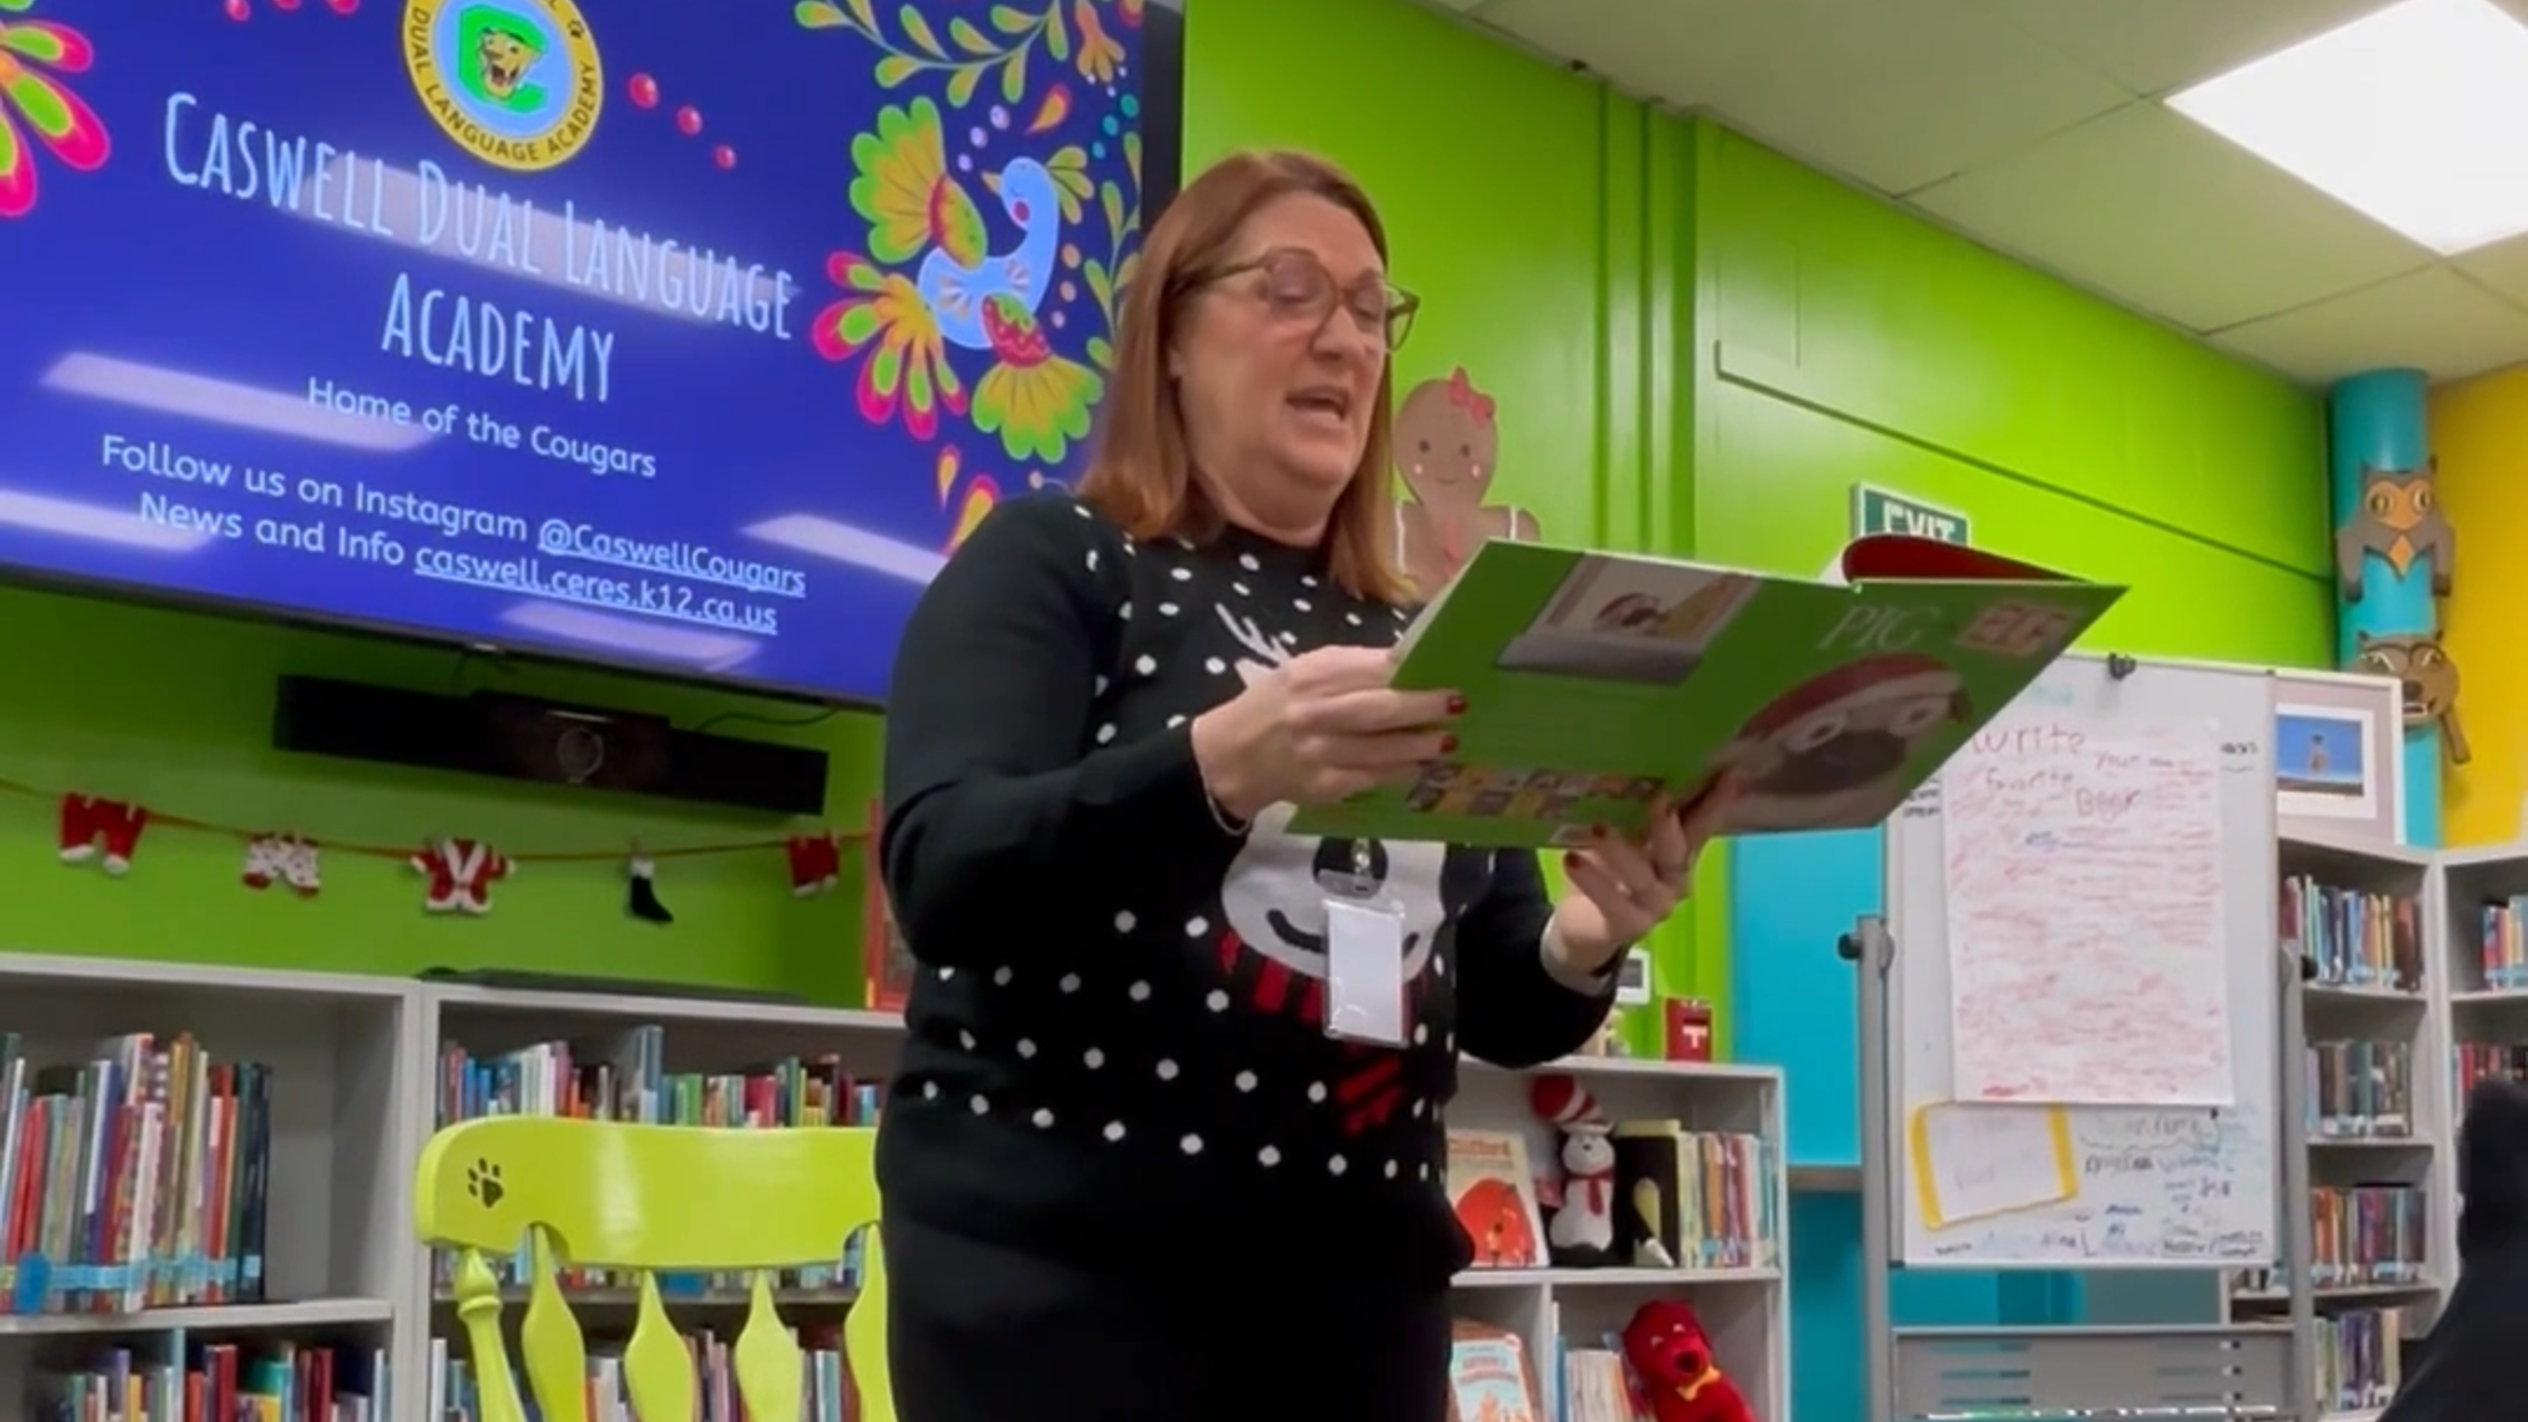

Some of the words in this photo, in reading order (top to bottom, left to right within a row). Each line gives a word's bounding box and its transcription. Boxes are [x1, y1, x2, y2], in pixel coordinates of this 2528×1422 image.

[409, 6, 432, 76] DUAL
[424, 82, 540, 162] LANGUAGE
[546, 60, 598, 154] ACADEMY
[164, 91, 394, 237] CASWELL
[418, 158, 542, 274] DUAL
[564, 199, 794, 340] LANGUAGE
[381, 272, 615, 403] ACADEMY
[307, 376, 411, 426] Home
[421, 403, 460, 436] of
[466, 412, 521, 449] the
[530, 425, 656, 478] Cougars
[102, 433, 232, 487] Follow
[244, 467, 286, 498] us
[297, 477, 343, 508] on
[355, 481, 528, 541] Instagram
[538, 518, 807, 599] @CaswellCougars
[139, 491, 243, 539] News
[255, 517, 325, 553] and
[338, 526, 405, 566] Info
[413, 544, 778, 636] caswell.ceres.k12.ca.us
